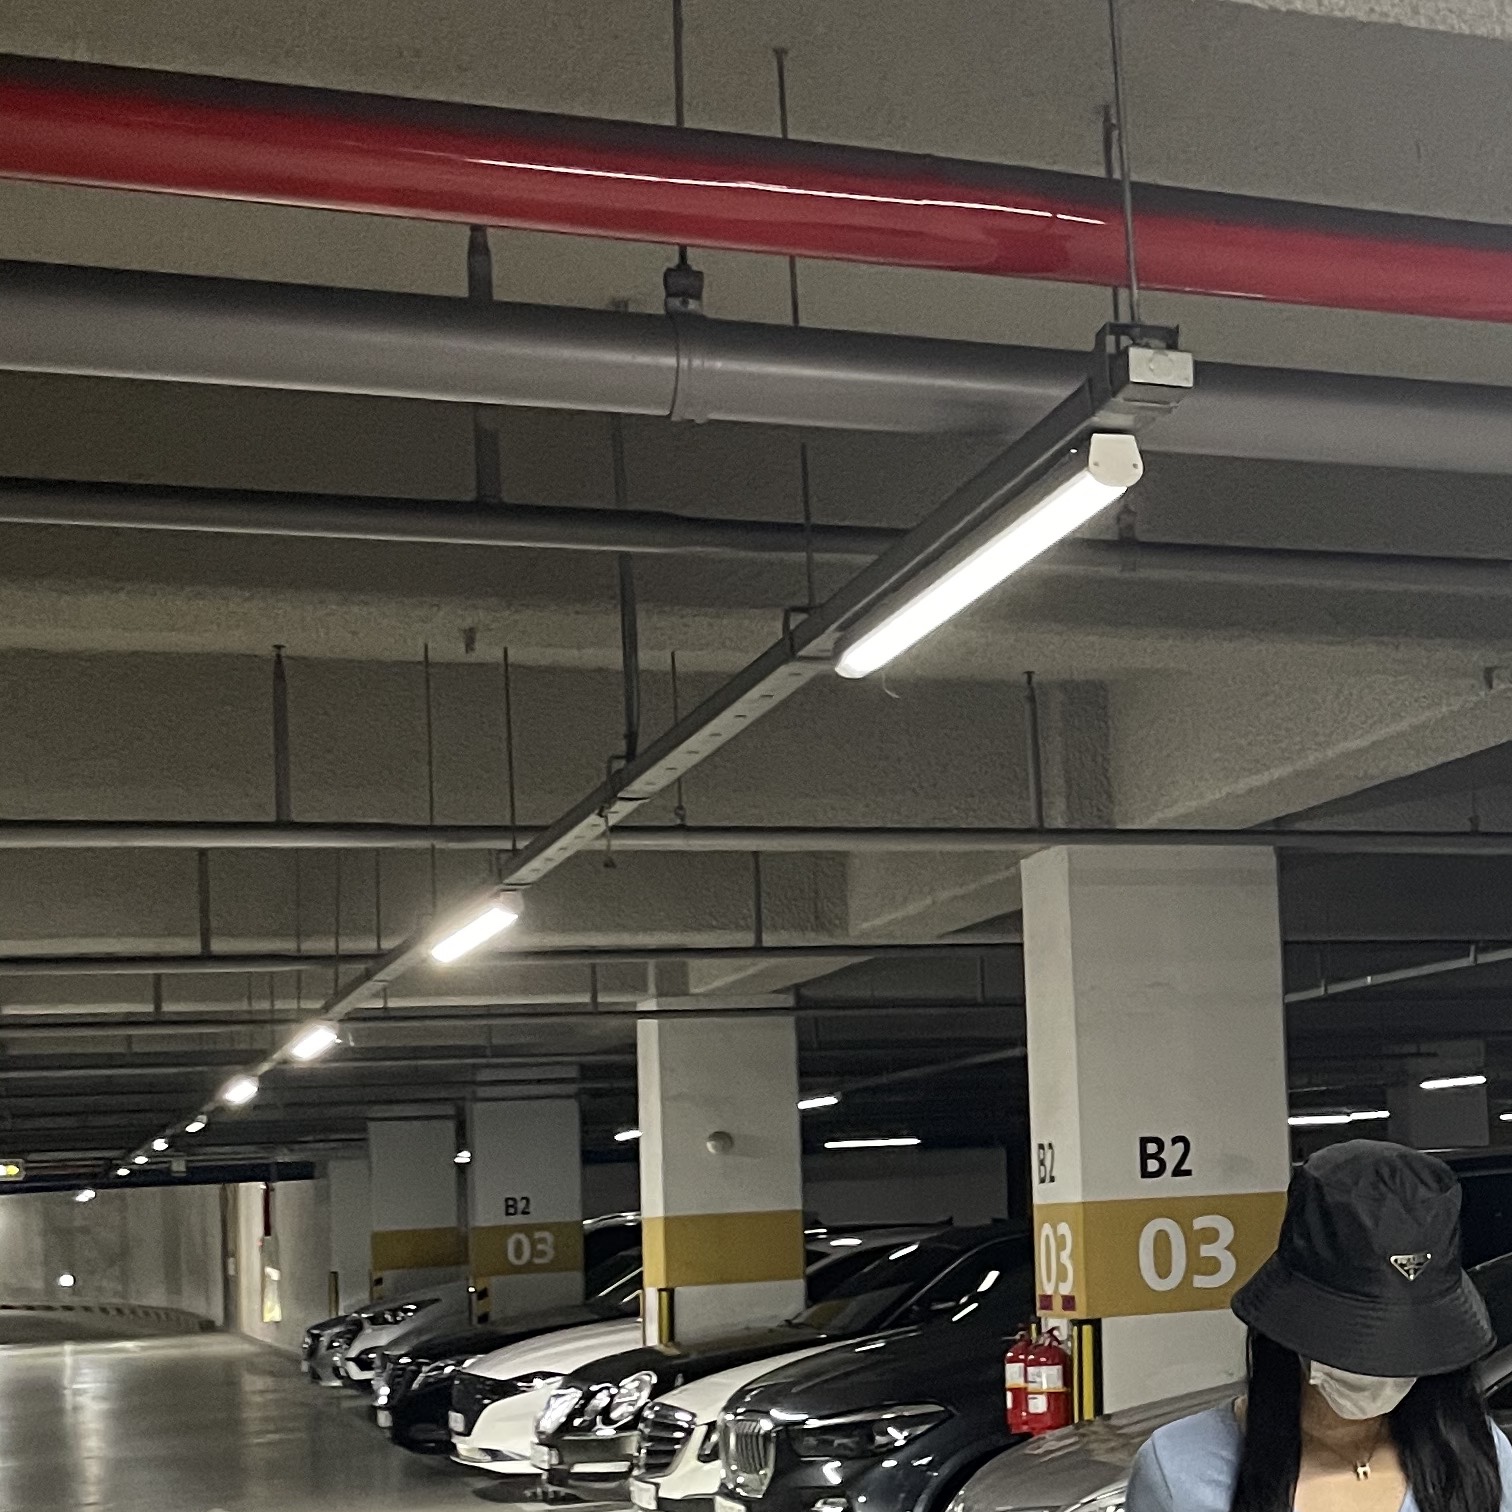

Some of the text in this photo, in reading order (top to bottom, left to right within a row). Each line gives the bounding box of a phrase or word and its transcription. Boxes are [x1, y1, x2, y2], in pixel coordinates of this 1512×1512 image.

[1037, 1142, 1056, 1185] B2
[1137, 1134, 1193, 1179] B2
[504, 1196, 531, 1217] B2
[506, 1230, 556, 1266] 03
[1040, 1222, 1074, 1296] 03
[1138, 1214, 1237, 1292] 03
